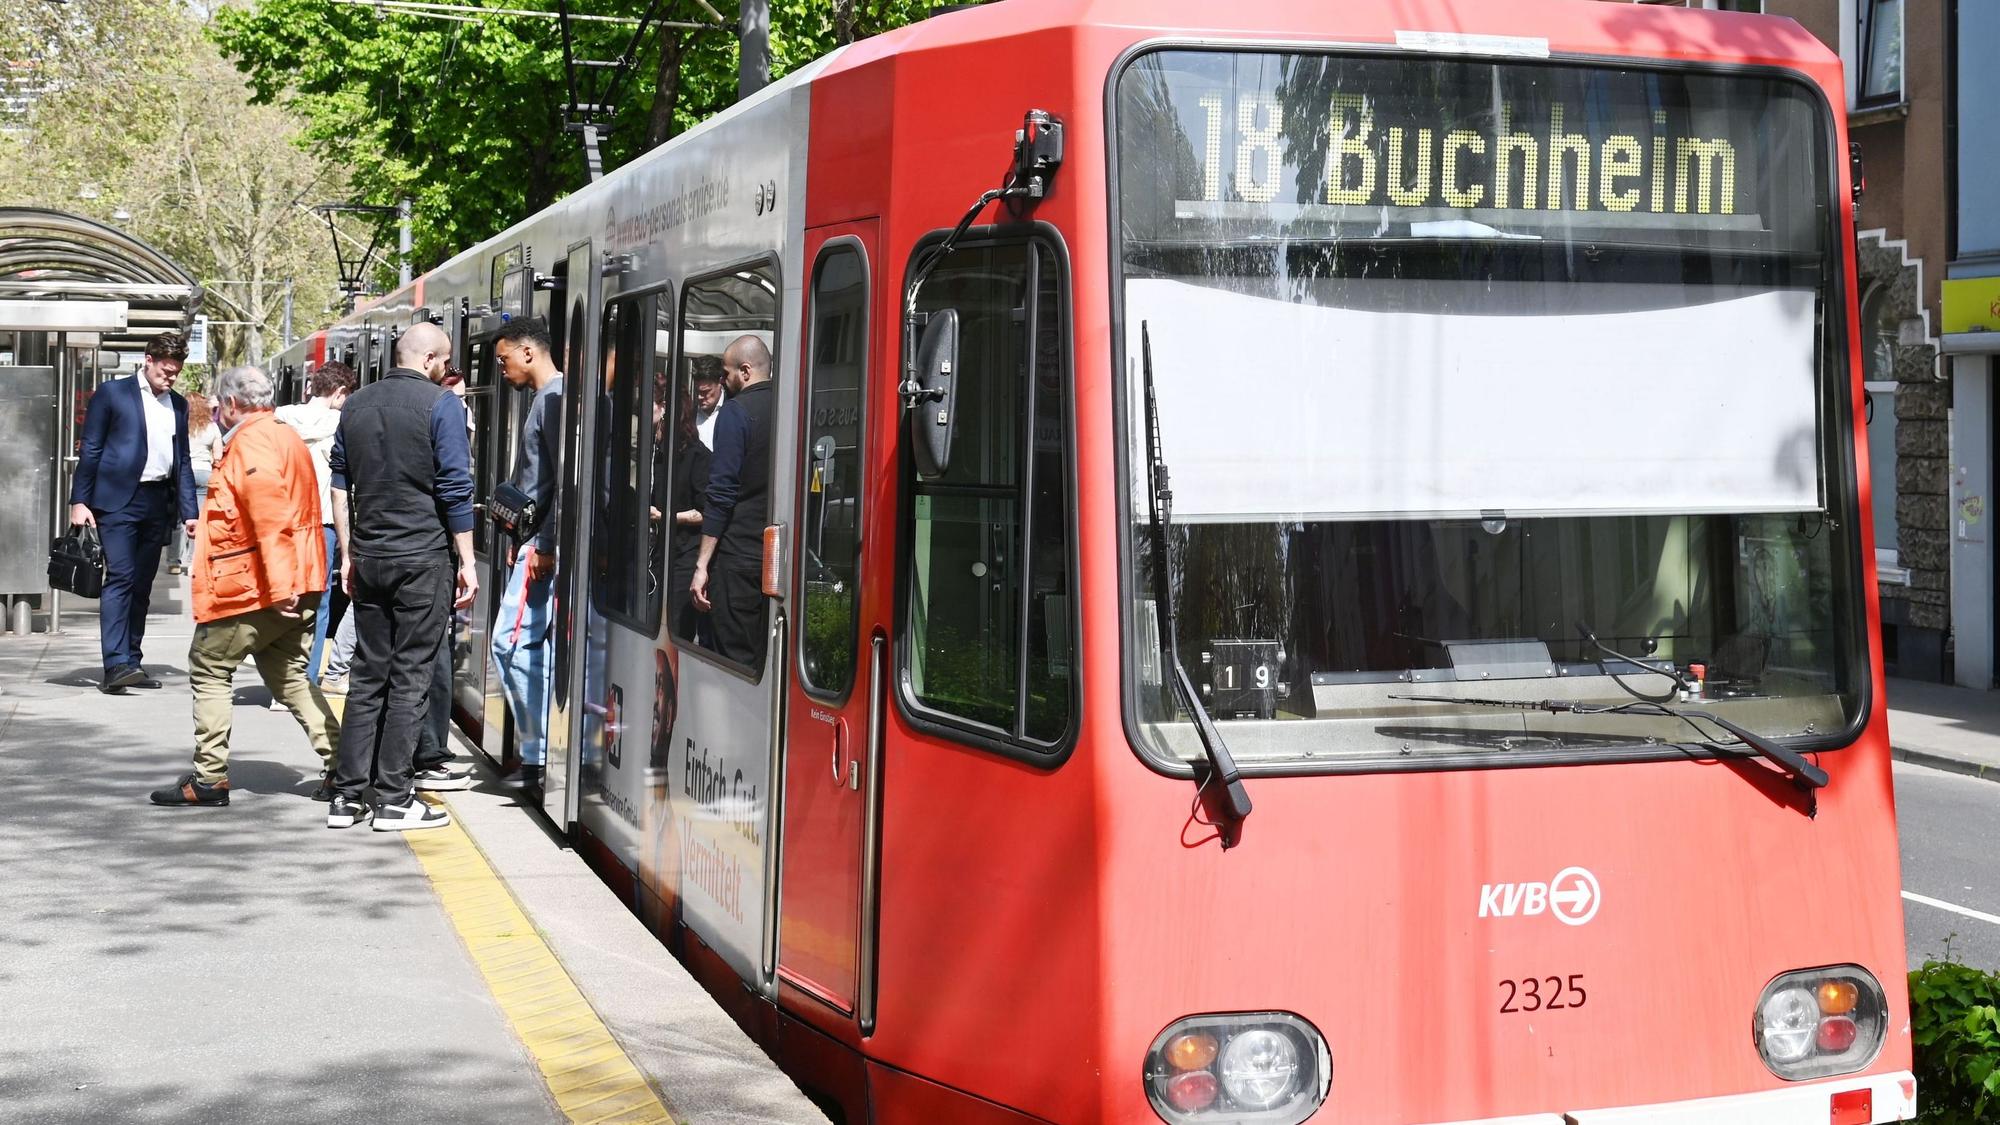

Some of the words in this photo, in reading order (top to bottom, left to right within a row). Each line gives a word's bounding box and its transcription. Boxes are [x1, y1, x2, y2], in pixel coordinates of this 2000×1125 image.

[1199, 93, 1284, 202] 18
[1326, 93, 1736, 214] Buchheim
[1478, 882, 1548, 918] KVB
[1498, 974, 1588, 1014] 2325
